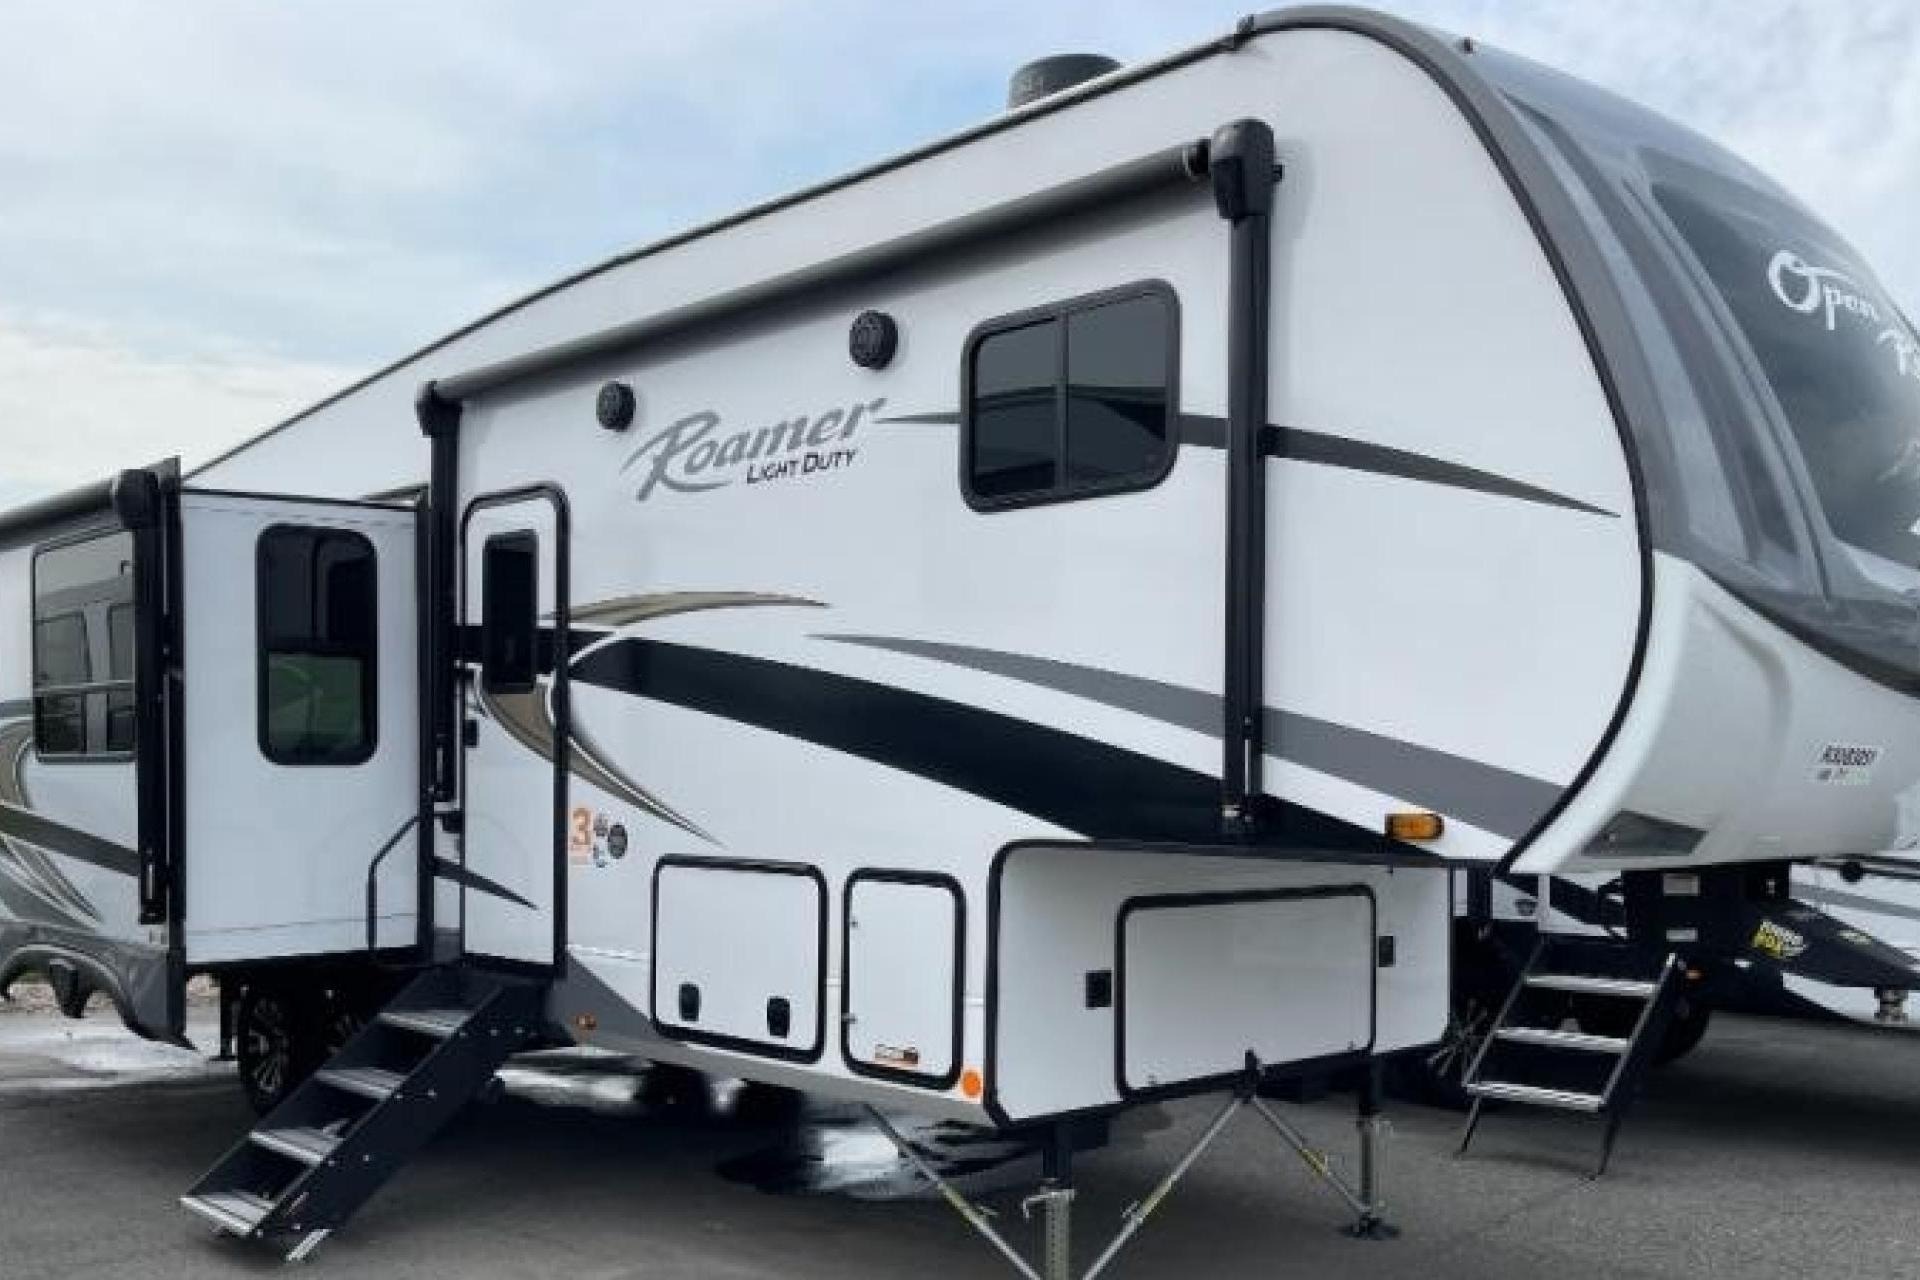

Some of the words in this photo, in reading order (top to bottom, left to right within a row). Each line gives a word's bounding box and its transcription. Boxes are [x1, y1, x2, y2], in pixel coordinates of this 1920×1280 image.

[619, 397, 887, 502] Roamer
[746, 459, 800, 484] LIGHT
[802, 449, 857, 473] DUTY
